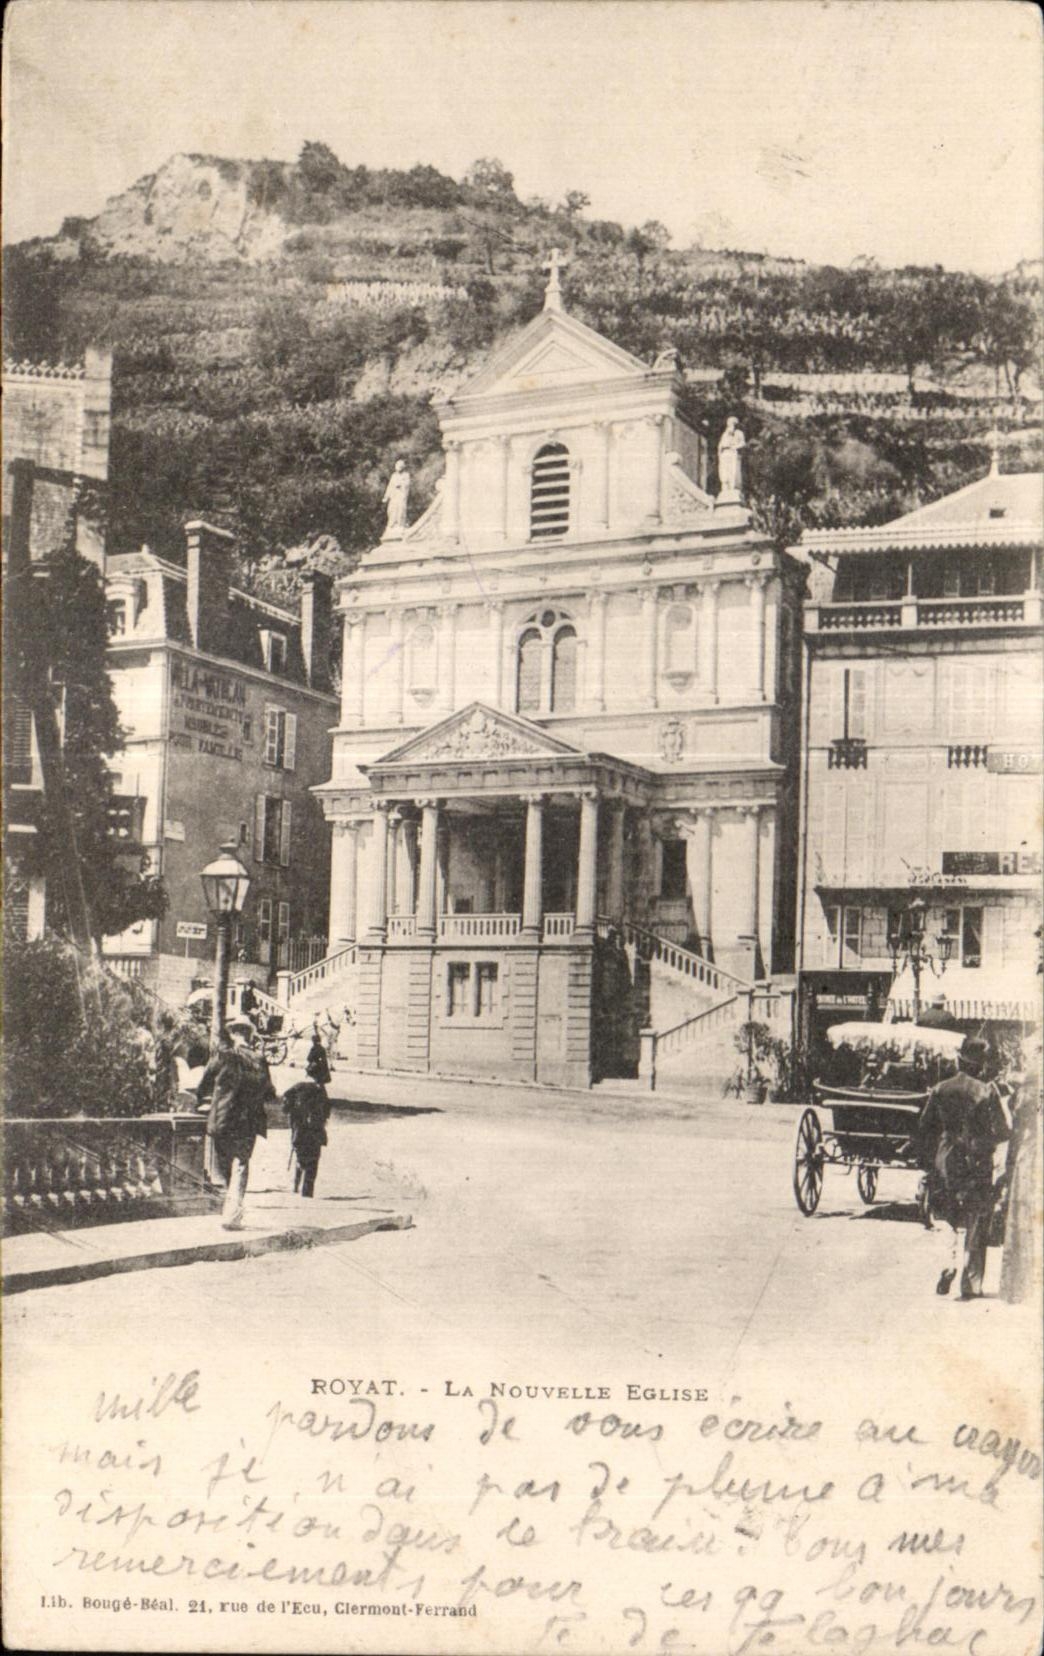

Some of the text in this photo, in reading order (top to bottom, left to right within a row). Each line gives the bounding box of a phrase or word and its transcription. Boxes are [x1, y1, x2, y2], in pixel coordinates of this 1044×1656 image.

[478, 1398, 521, 1445] de
[564, 1411, 664, 1442] vous
[856, 1418, 930, 1446] au
[471, 1473, 561, 1516] pas
[589, 1462, 630, 1500] de
[652, 1450, 835, 1520] plume
[461, 1565, 583, 1606] pour
